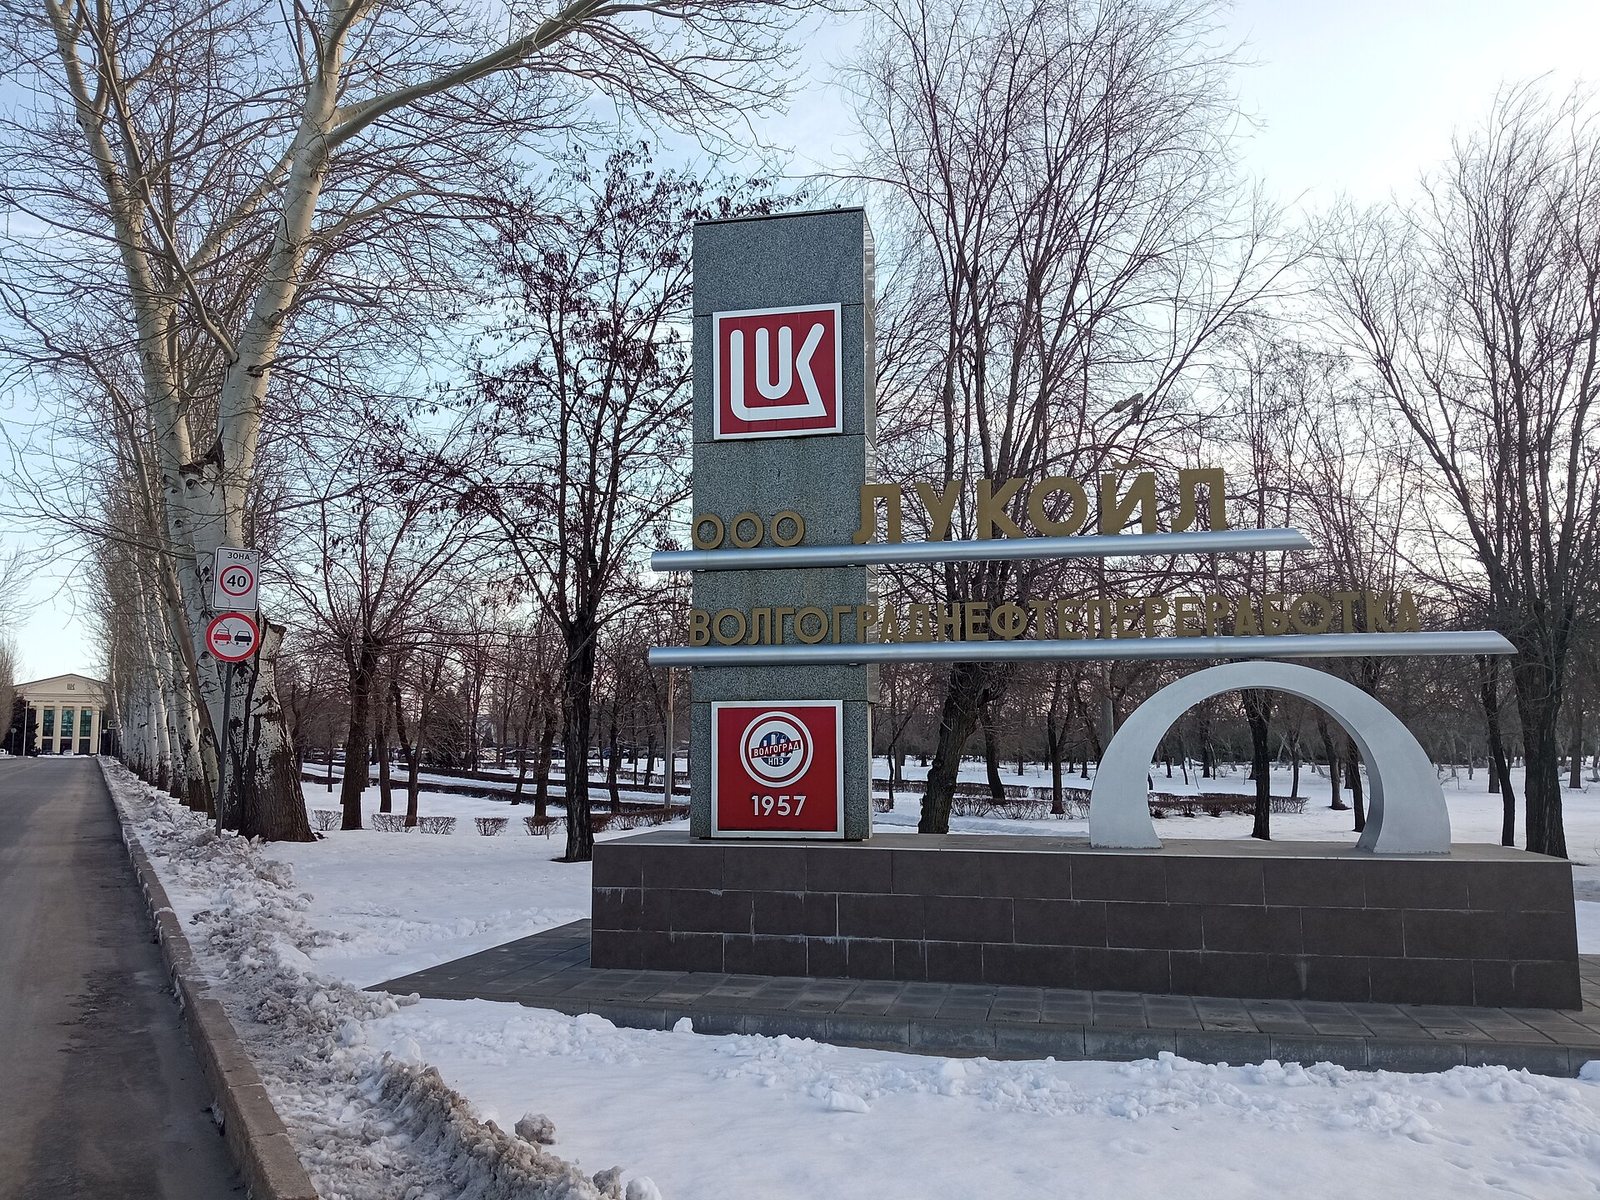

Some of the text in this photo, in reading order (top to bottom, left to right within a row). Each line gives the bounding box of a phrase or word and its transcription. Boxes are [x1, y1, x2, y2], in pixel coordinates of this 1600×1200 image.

[691, 460, 1226, 550] ООО ЛУКОЙЛ
[227, 551, 251, 561] ЗОНА
[226, 574, 247, 588] 40
[688, 589, 1421, 647] ВОЛГОГРАДНЕФТЕПЕРЕРАБОТКА
[753, 741, 800, 757] ВОЛГОГРАД
[768, 757, 784, 766] НПЗ
[751, 795, 807, 816] 1957
